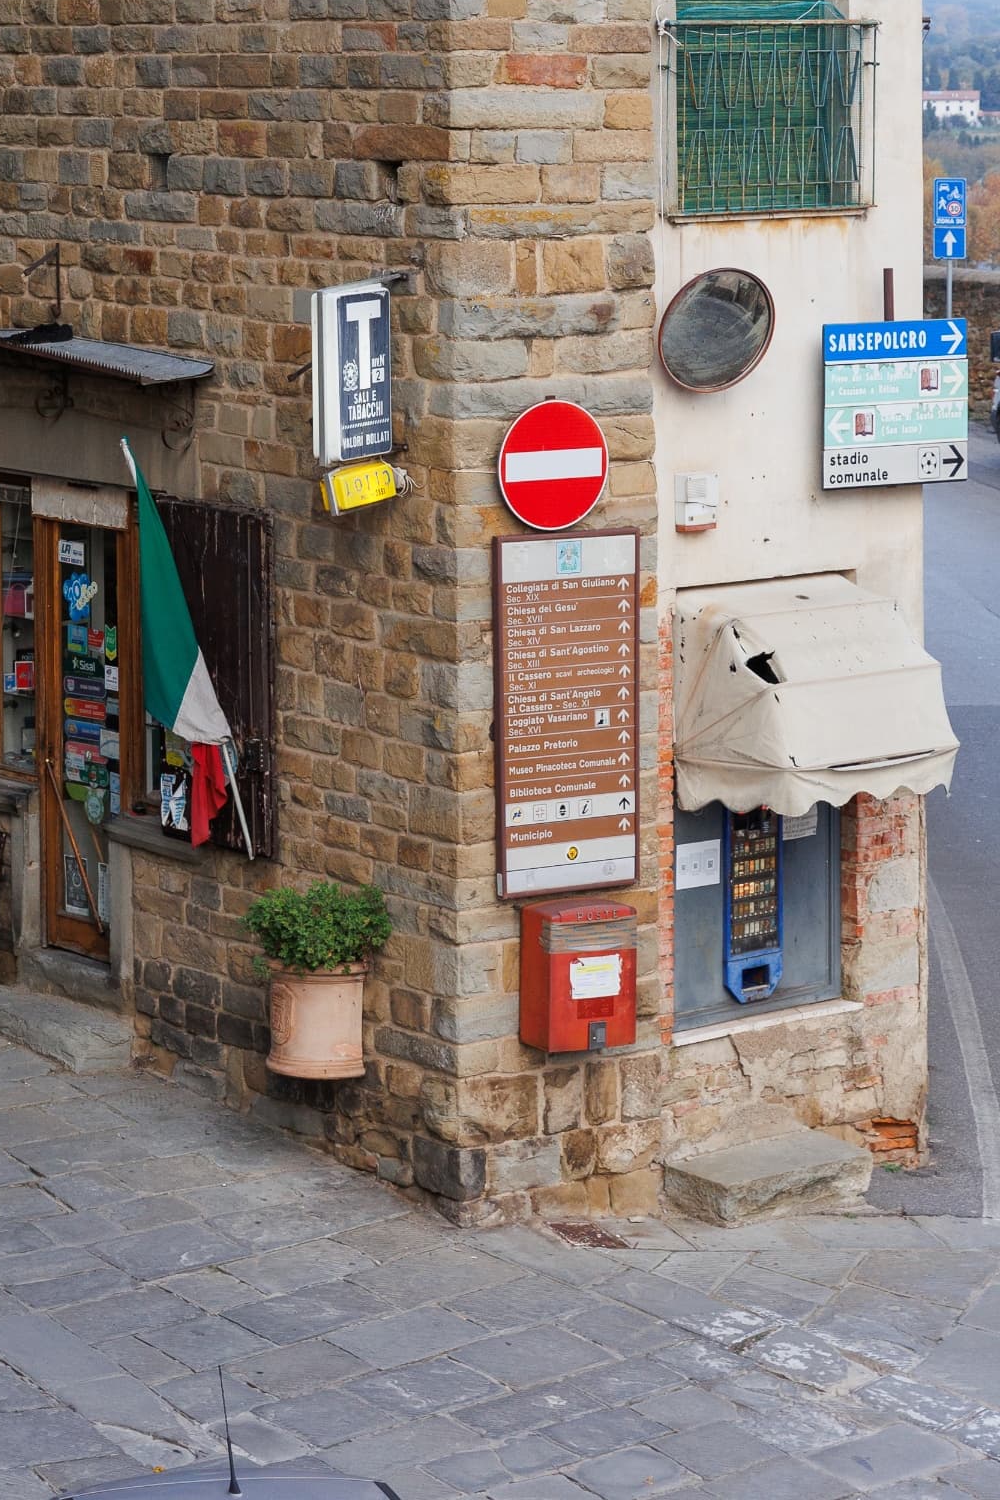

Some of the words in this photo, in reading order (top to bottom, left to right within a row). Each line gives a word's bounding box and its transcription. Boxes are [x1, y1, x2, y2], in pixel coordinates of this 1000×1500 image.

[346, 300, 380, 389] T
[829, 330, 927, 352] SANSEPOLCRO
[376, 370, 381, 380] 2
[353, 391, 369, 405] SALI
[371, 389, 377, 400] E
[347, 400, 384, 421] TABACCHI
[365, 430, 390, 445] BOLLATI
[830, 452, 868, 466] stadio
[829, 468, 888, 484] comunale
[506, 582, 548, 594] Collegiata
[552, 581, 559, 590] di
[562, 580, 578, 590] San
[582, 578, 616, 588] Giuliano
[507, 606, 536, 616] Chiesa
[538, 604, 552, 613] del
[526, 616, 543, 624] XVII
[508, 628, 536, 638] Chiesa
[539, 626, 547, 635] di
[550, 625, 566, 634] San
[570, 623, 600, 632] Lazzaro
[527, 637, 540, 645] XIV
[508, 651, 536, 660] Chiesa
[539, 648, 547, 657] di
[550, 644, 609, 656] Sant'Agostino
[79, 660, 96, 672] Sisal
[527, 660, 540, 668] XIII
[509, 674, 514, 682] Il
[518, 671, 552, 681] Cassero
[555, 670, 572, 678] scavi
[576, 667, 614, 676] archeologici
[508, 696, 536, 704] Chiesa
[539, 693, 547, 701] di
[550, 688, 601, 700] Sant'Angelo
[508, 706, 516, 714] al
[520, 703, 552, 712] Cassero
[581, 699, 590, 707] XI
[509, 716, 544, 727] Loggiato
[547, 712, 588, 722] Vasariano
[528, 726, 541, 734] XVI
[508, 743, 540, 753] Palazzo
[544, 739, 578, 749] Pretorio
[509, 766, 533, 775] Museo
[536, 761, 576, 772] Pinacoteca
[579, 757, 616, 768] Comunale
[510, 786, 552, 798] Biblioteca
[555, 781, 596, 792] Comunale
[510, 830, 552, 842] Municipio
[577, 909, 618, 921] POSTE
